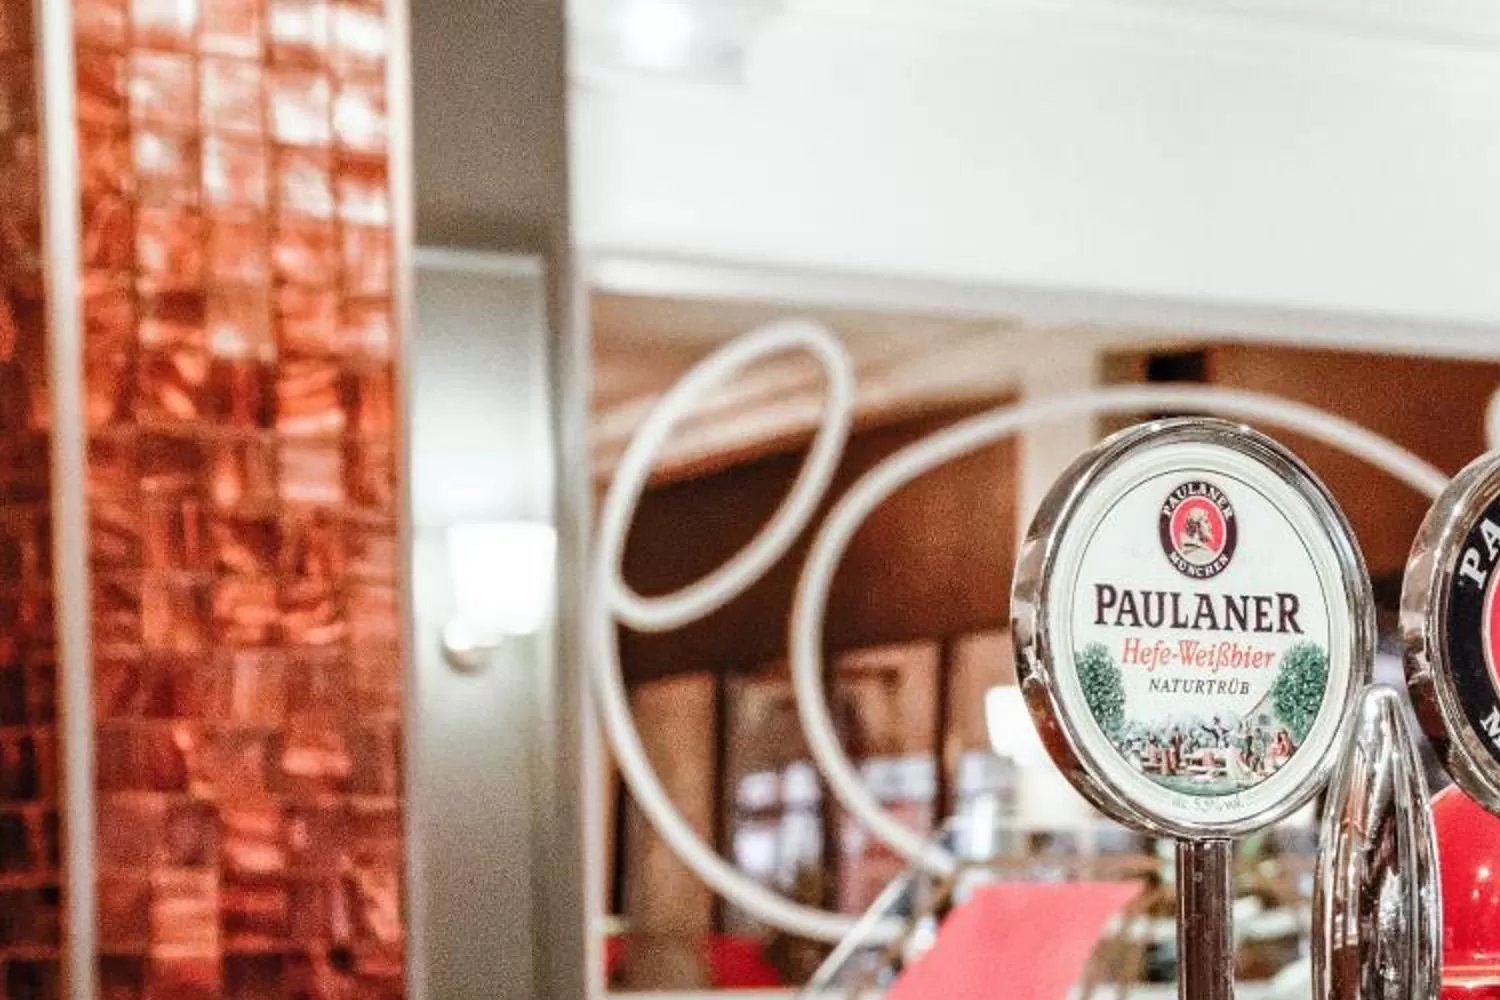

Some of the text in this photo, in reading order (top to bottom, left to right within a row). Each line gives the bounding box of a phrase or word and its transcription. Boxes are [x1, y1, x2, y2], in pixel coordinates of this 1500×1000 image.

[1161, 483, 1233, 520] PAULANER
[1093, 583, 1305, 635] PAULANER
[1121, 637, 1277, 673] Hefe-Weißbier
[1148, 677, 1250, 695] NATURTRÜB
